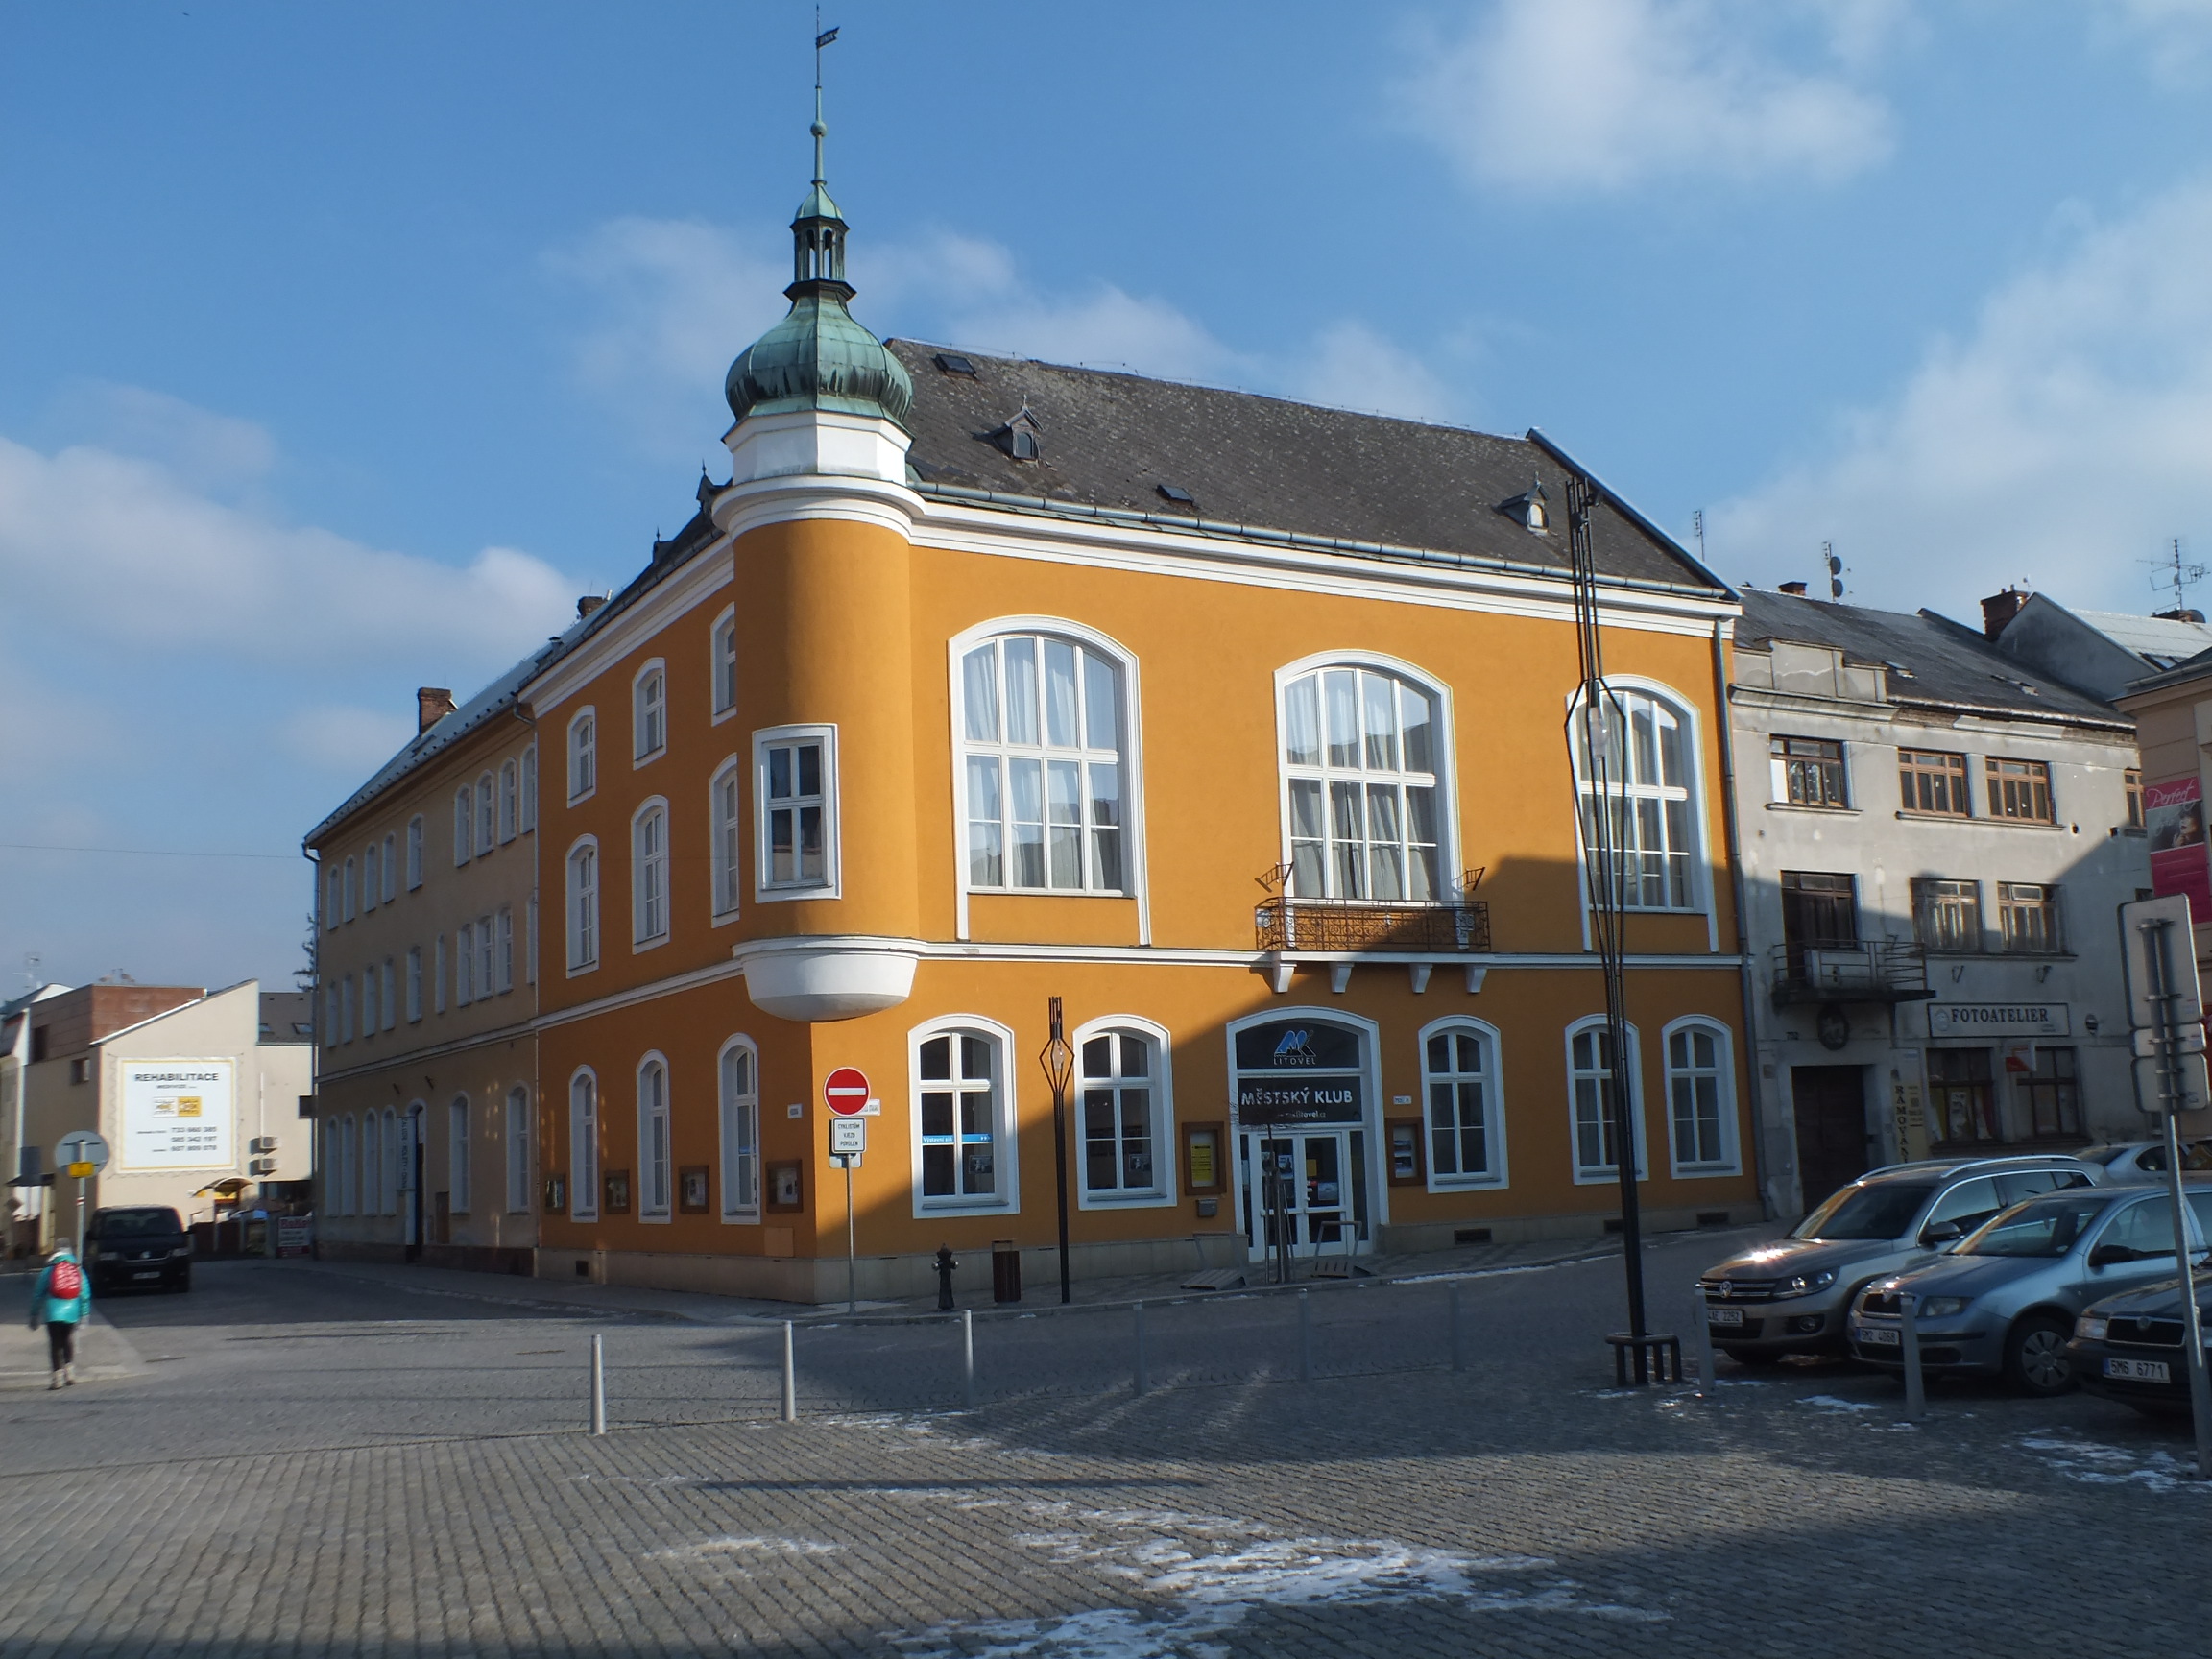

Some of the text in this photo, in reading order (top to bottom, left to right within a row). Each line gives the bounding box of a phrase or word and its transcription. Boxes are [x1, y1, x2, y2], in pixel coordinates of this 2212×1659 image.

[2146, 779, 2196, 811] Perfect
[1951, 1008, 2049, 1022] FOTOATELIER
[1241, 1086, 1353, 1105] MĚSTSKÝ KLUB
[2111, 1359, 2163, 1378] 5M6 6771
